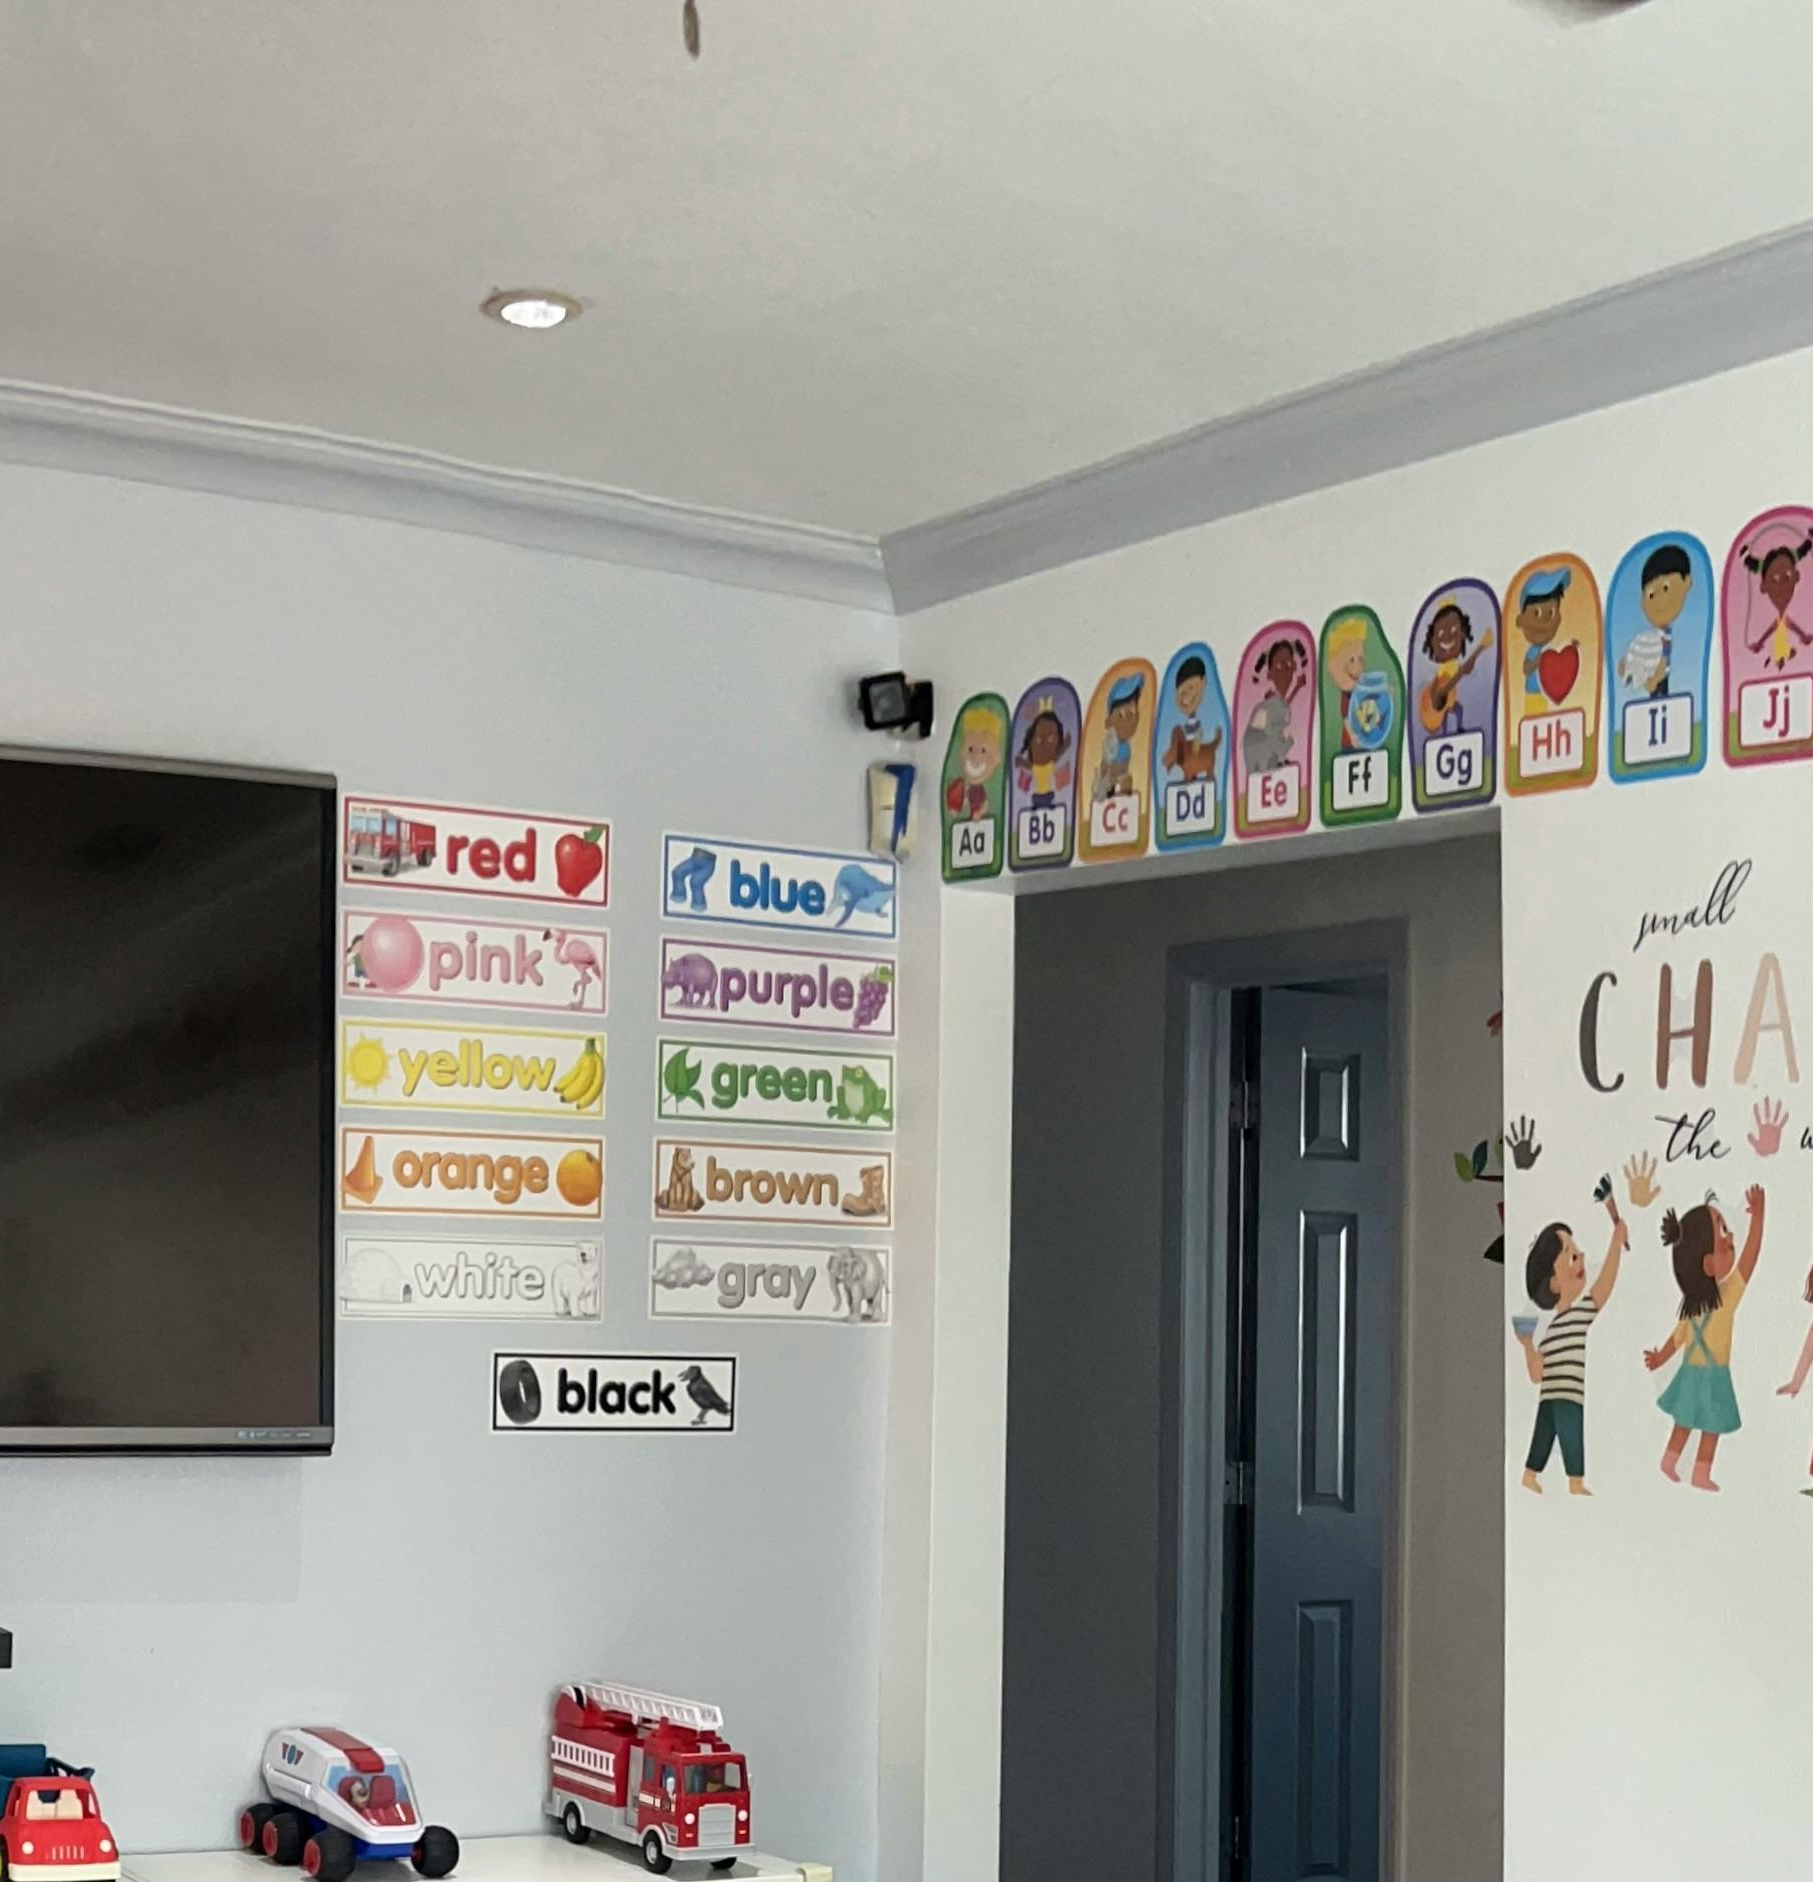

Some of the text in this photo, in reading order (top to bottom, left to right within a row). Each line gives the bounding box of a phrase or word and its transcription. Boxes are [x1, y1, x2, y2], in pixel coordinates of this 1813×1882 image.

[1647, 711, 1668, 750] Ii
[1765, 689, 1793, 732] Jj
[1435, 744, 1474, 782] Gg
[1531, 725, 1572, 761] Hh
[1259, 776, 1287, 806] Ee
[1347, 759, 1374, 794] Ff
[1027, 812, 1055, 844] Bb
[1102, 803, 1129, 832] Cc
[1175, 790, 1206, 819] Dd
[446, 827, 537, 883] red
[958, 829, 985, 858] Aa
[729, 859, 825, 916] blue
[1633, 859, 1753, 953] small
[428, 931, 542, 991] pink
[719, 961, 853, 1017] purple
[397, 1040, 556, 1095] yellow
[711, 1064, 832, 1108] green
[1655, 1109, 1730, 1161] the
[392, 1149, 549, 1205] orange
[706, 1157, 838, 1206] brown
[414, 1251, 545, 1301] white
[717, 1256, 817, 1308] gray
[557, 1368, 676, 1416] black
